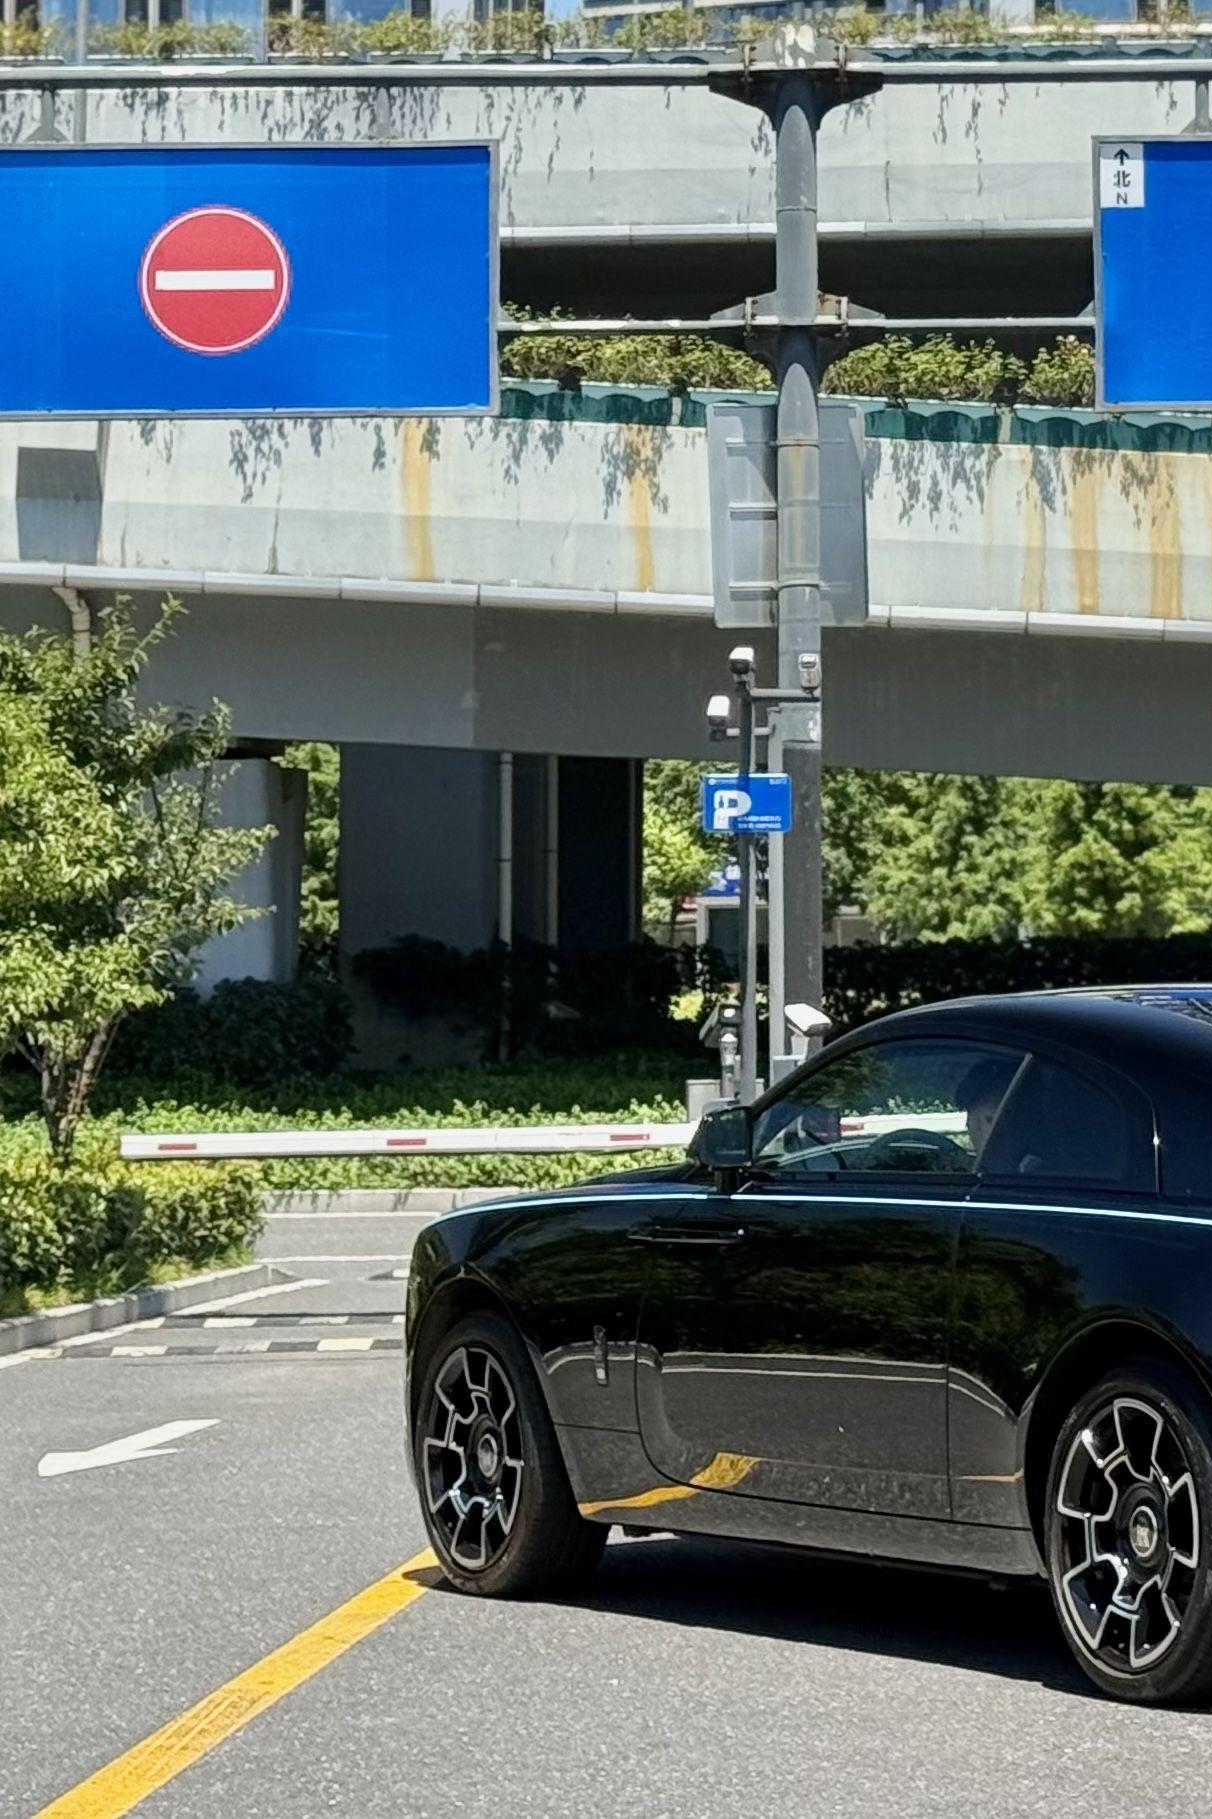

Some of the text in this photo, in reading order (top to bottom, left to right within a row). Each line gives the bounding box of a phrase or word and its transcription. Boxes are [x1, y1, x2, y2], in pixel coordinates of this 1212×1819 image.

[1113, 170, 1131, 188] 北
[1116, 192, 1128, 205] N
[713, 790, 752, 830] P
